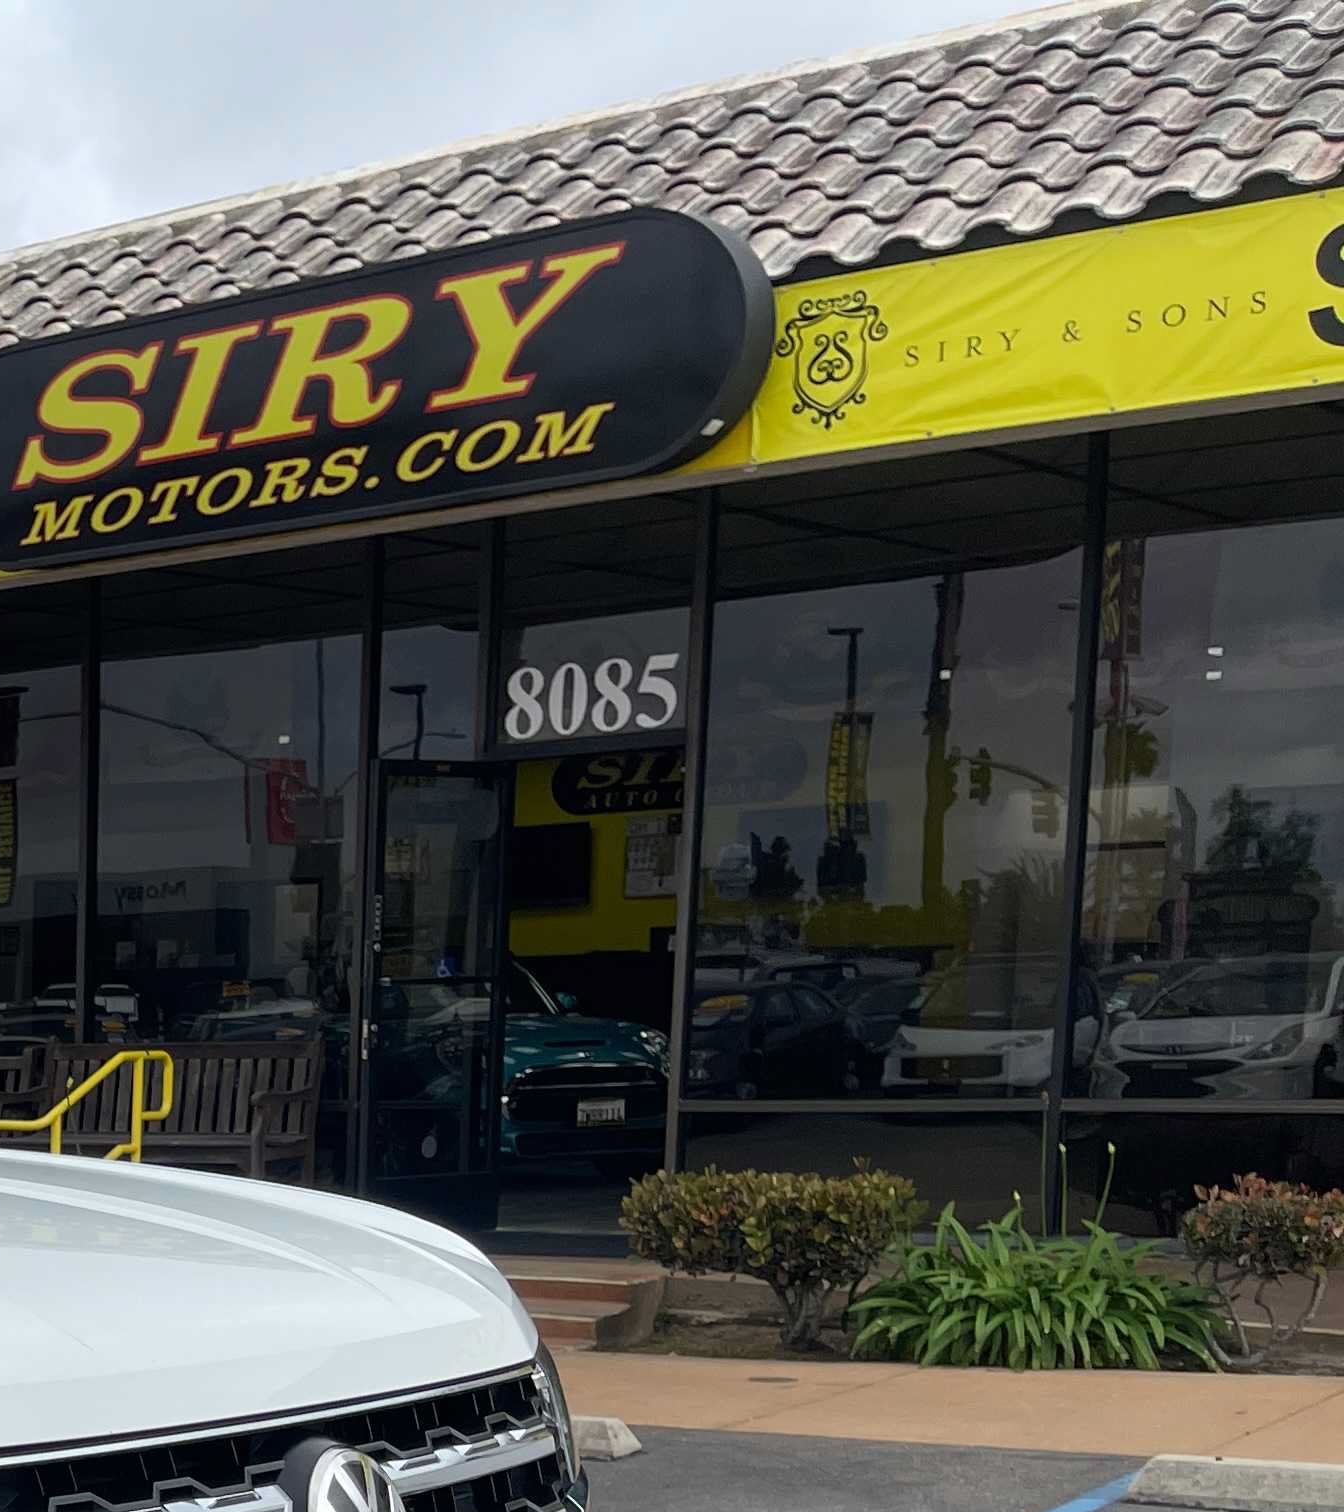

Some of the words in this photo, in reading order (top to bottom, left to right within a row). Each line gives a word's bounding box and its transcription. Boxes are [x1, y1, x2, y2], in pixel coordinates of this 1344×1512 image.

[11, 240, 626, 490] SIRY
[904, 327, 1022, 368] SIRY
[1061, 319, 1082, 343] &
[1126, 290, 1268, 333] SONS
[19, 401, 617, 547] MOTORS.COM
[503, 651, 681, 741] 8085
